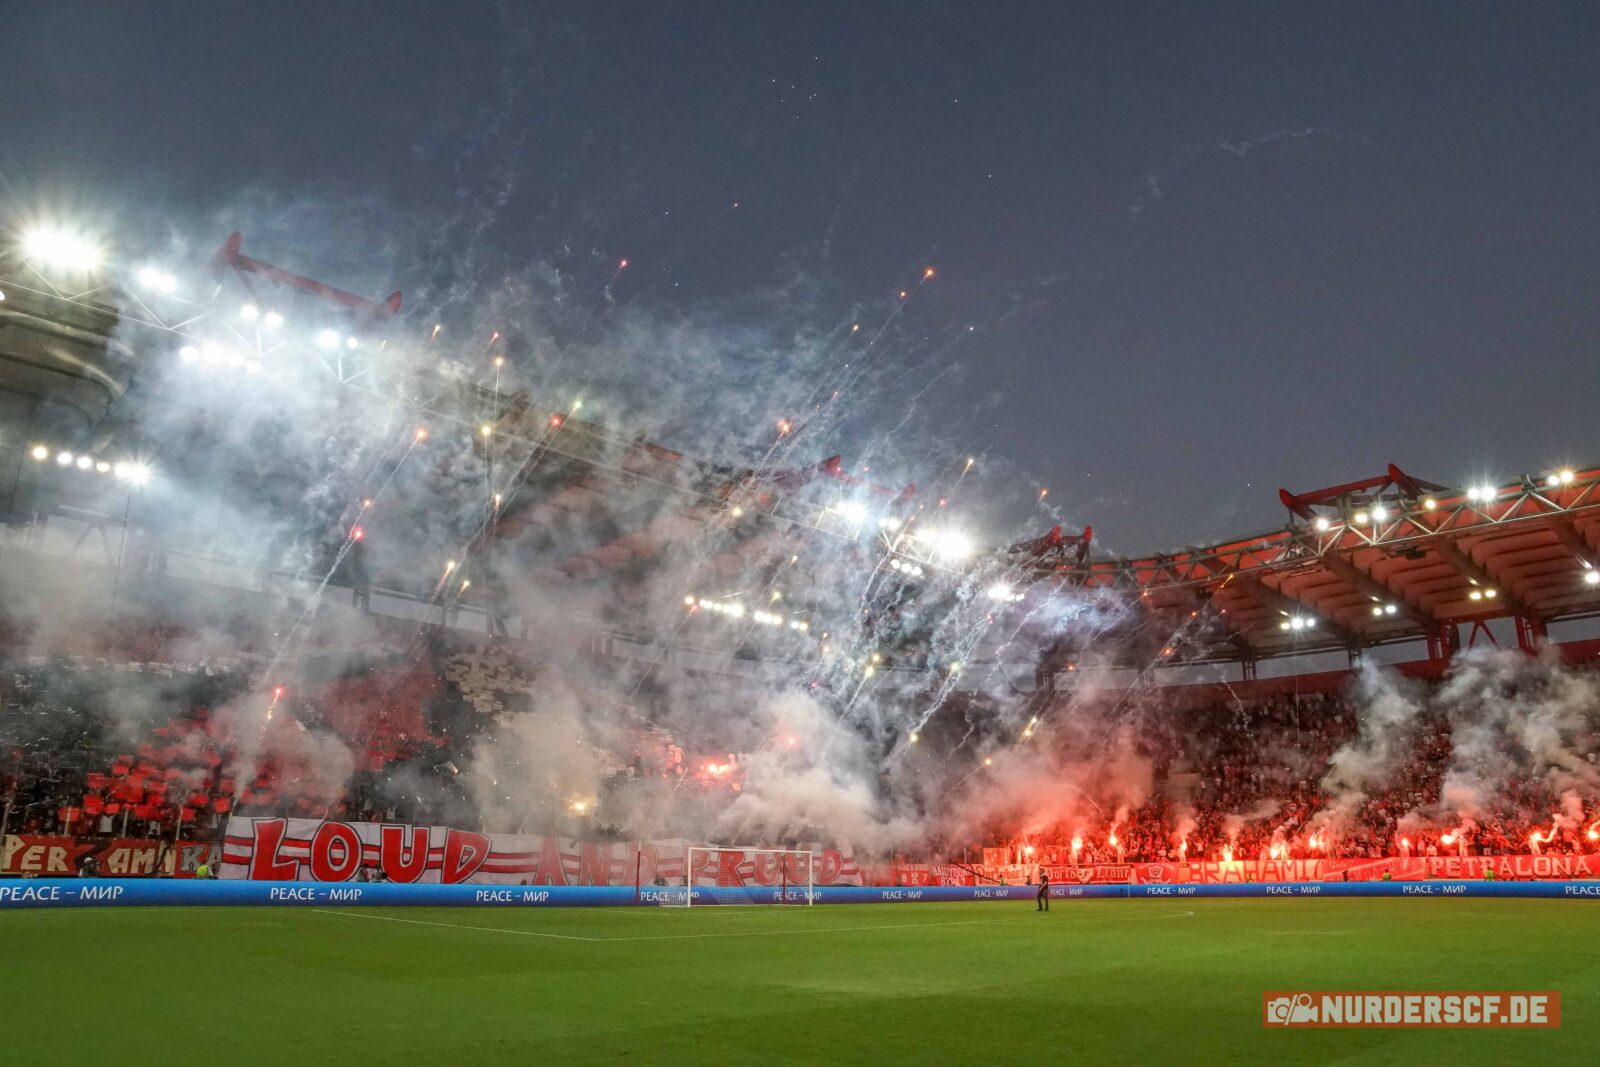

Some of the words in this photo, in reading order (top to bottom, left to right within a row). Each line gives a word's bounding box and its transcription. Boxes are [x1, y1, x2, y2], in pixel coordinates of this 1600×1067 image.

[2, 835, 68, 872] PER
[250, 818, 492, 884] LOUD
[533, 832, 658, 886] AND
[682, 843, 843, 886] PROUD
[1430, 855, 1592, 876] PETRALONA
[1190, 860, 1309, 883] BRAHAMI
[0, 886, 60, 900] PEACE
[270, 888, 315, 900] PEACE
[882, 891, 902, 899] PEACE
[974, 889, 991, 897] PEACE
[1147, 887, 1171, 895] PEACE
[1266, 886, 1292, 894] PEACE
[1402, 885, 1433, 894] PEACE
[1564, 885, 1600, 896] PEACE
[476, 891, 512, 902] PEACE
[640, 891, 670, 901] PEACE
